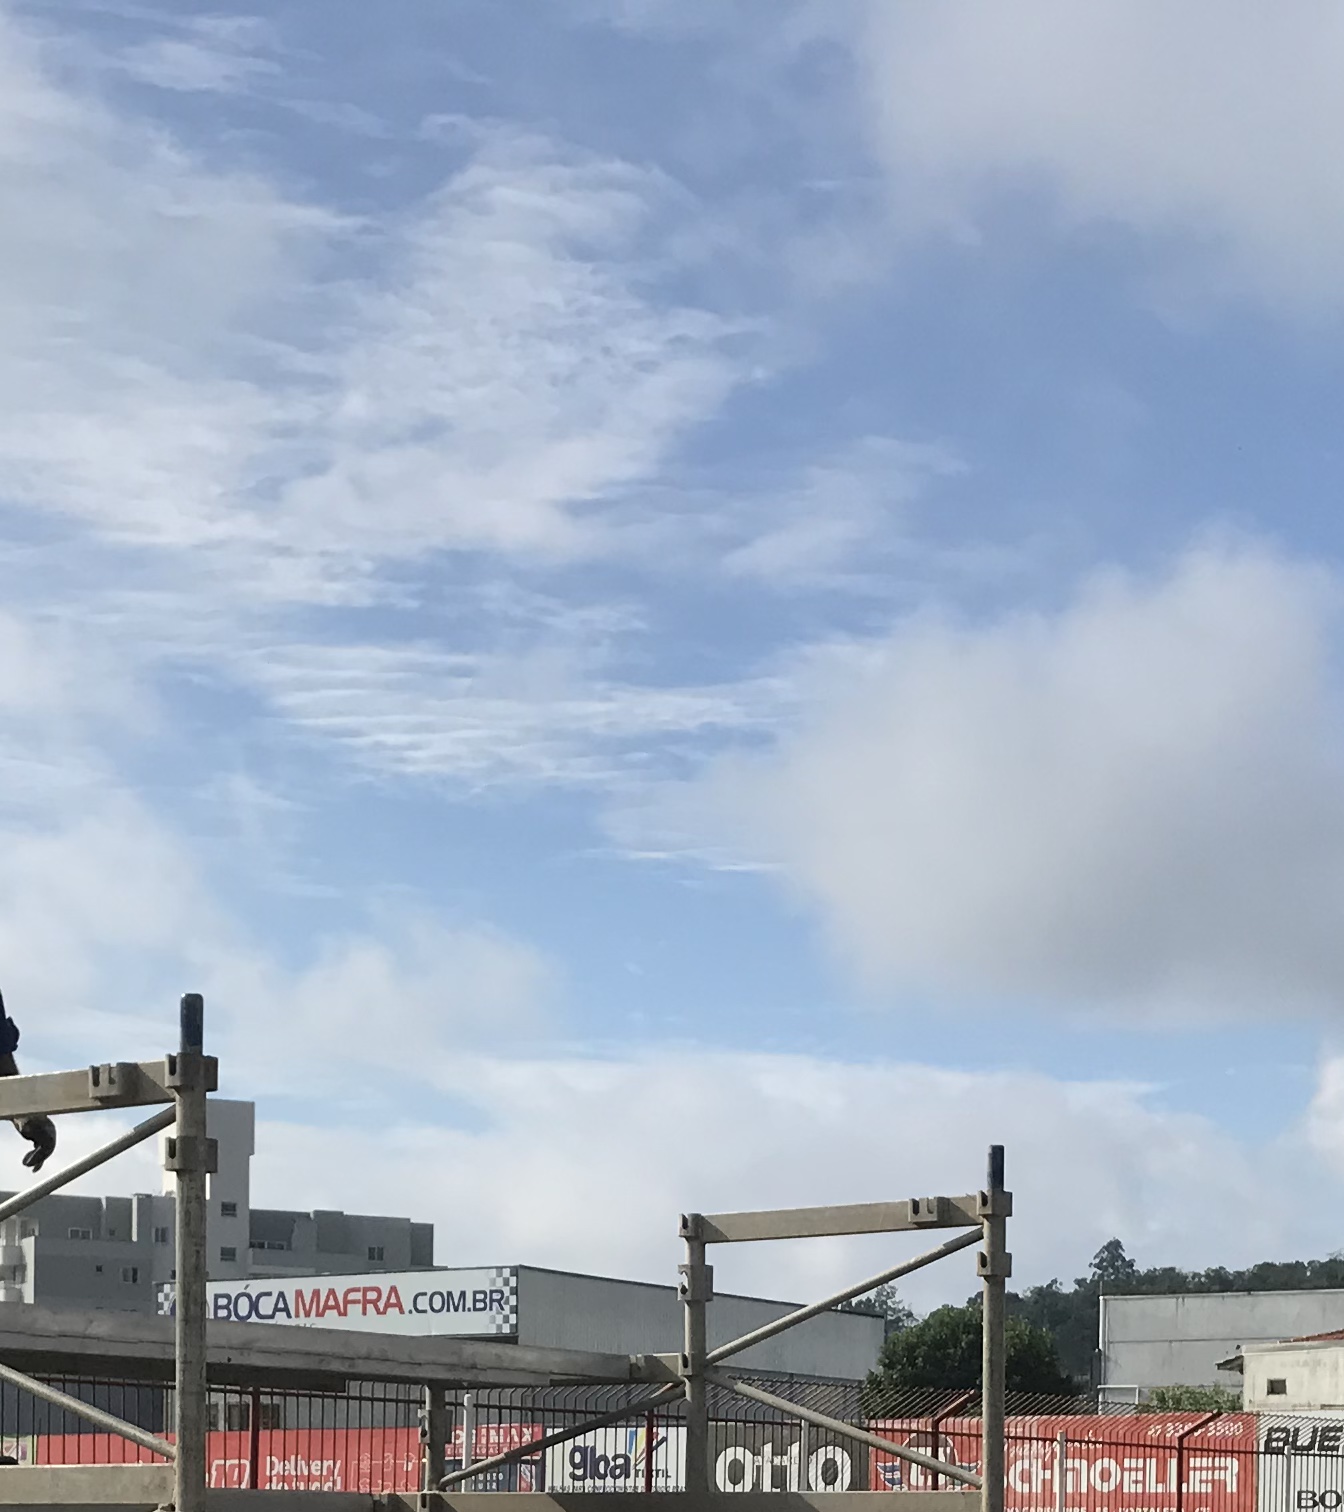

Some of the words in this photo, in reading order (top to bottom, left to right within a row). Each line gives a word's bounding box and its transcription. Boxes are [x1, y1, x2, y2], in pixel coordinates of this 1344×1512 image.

[265, 1454, 342, 1480] Delivery
[635, 1468, 672, 1479] TTIL
[1003, 1456, 1239, 1494] CHNOELLER
